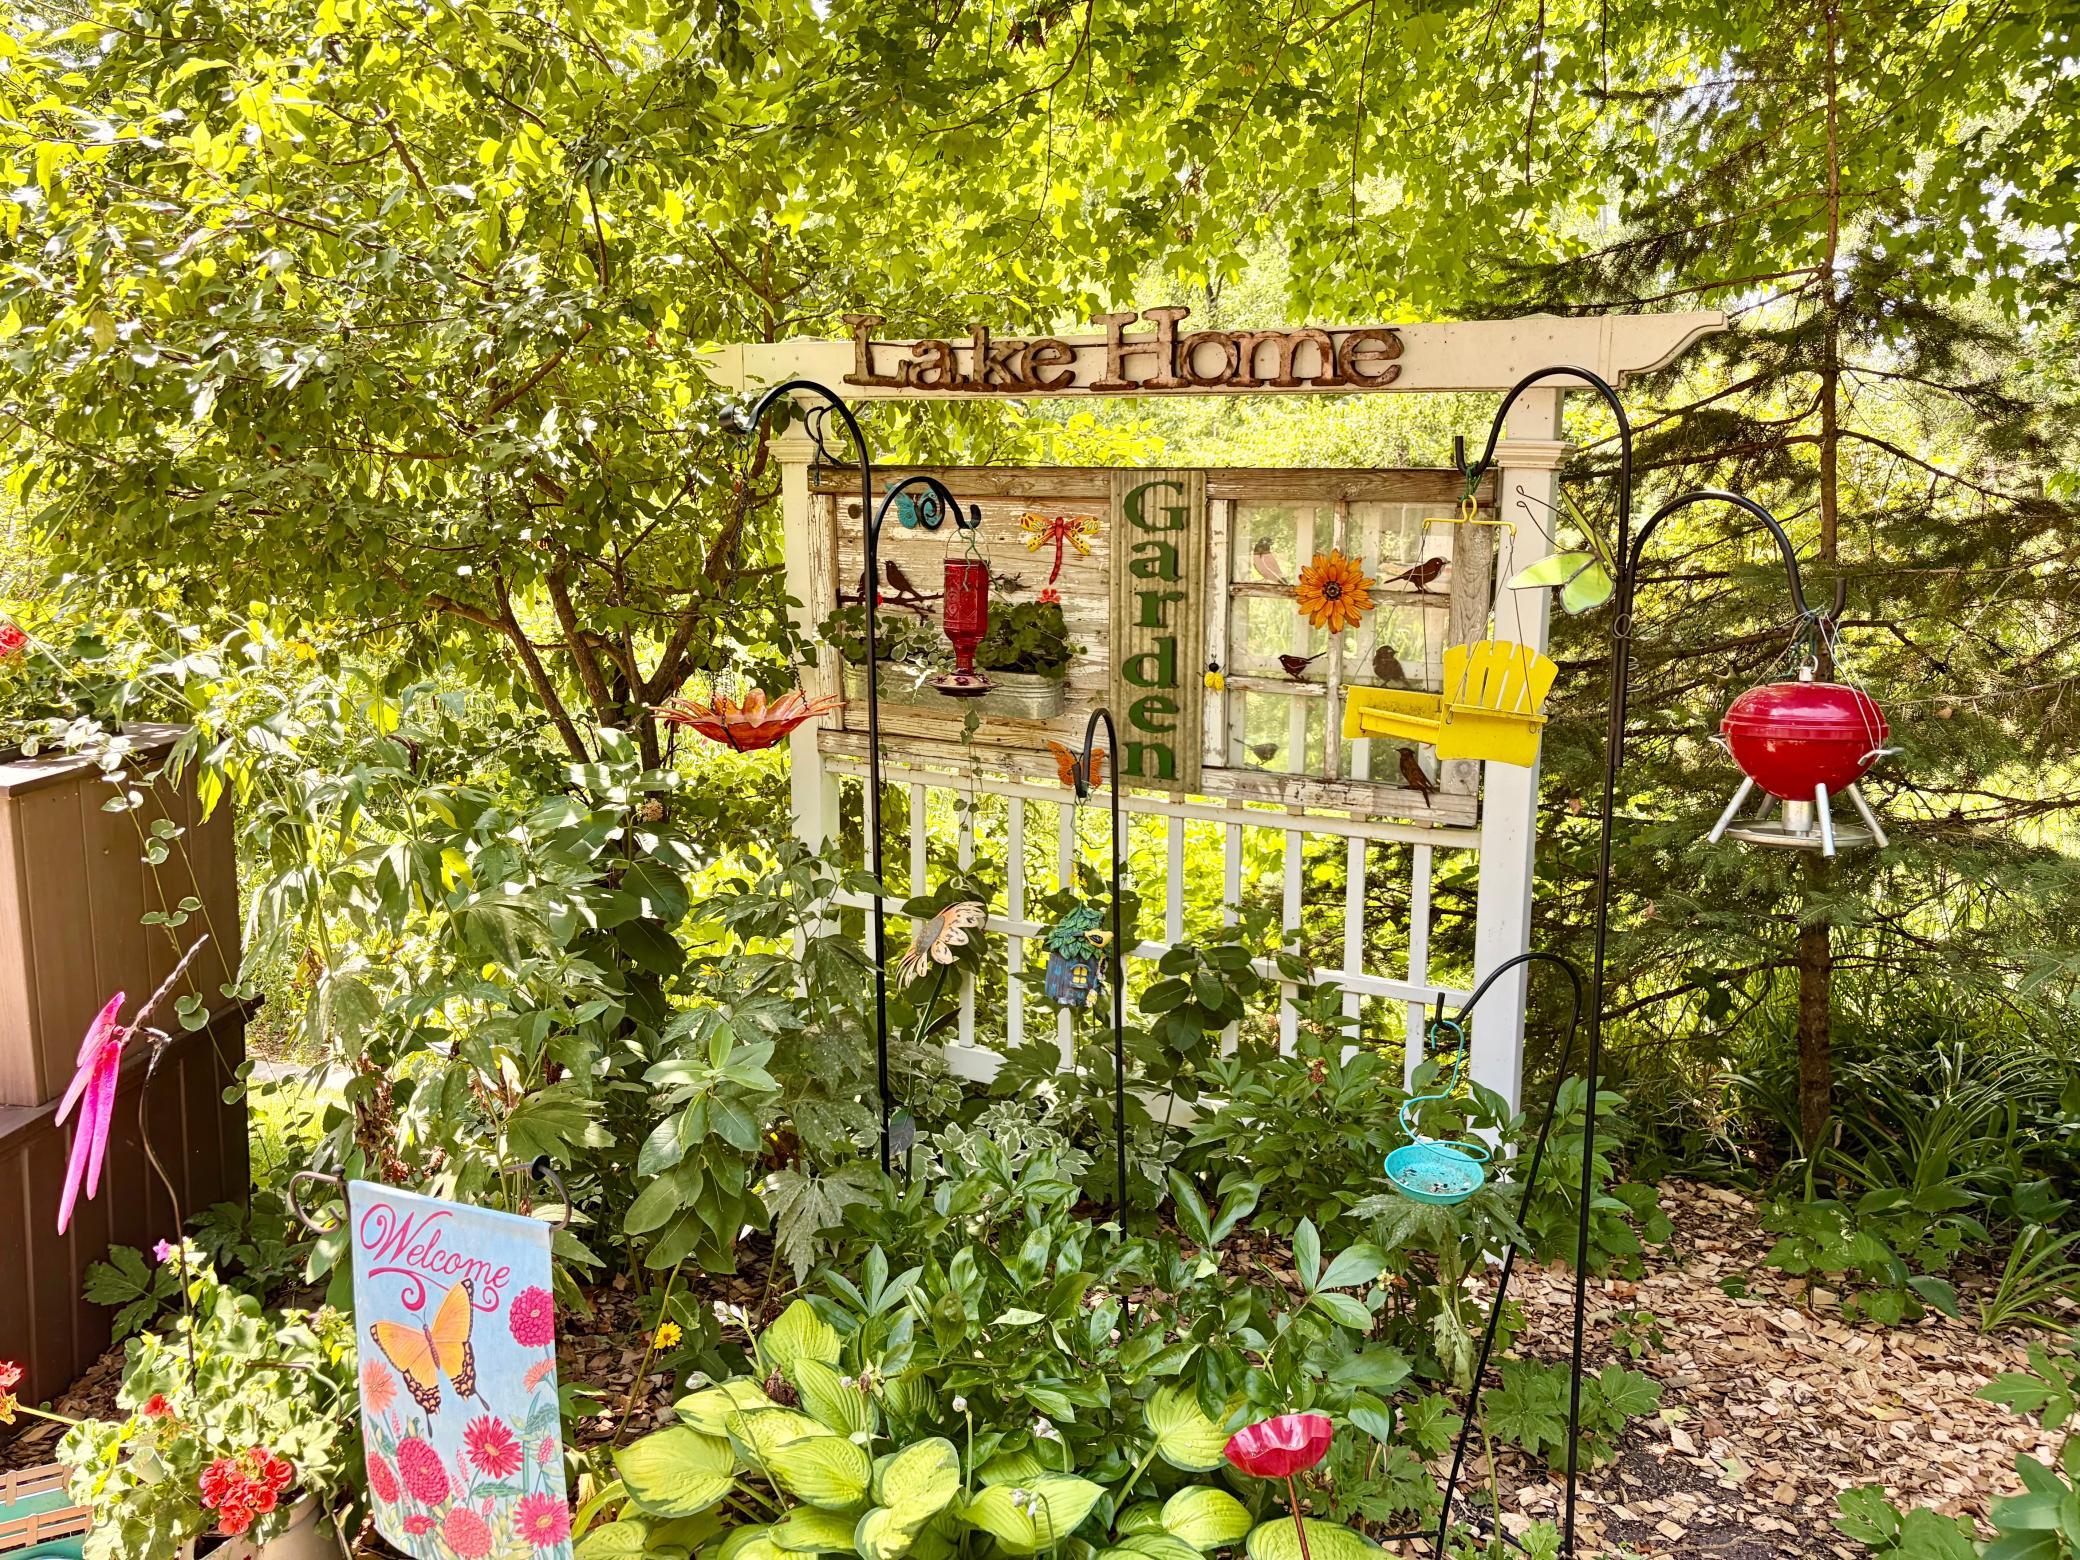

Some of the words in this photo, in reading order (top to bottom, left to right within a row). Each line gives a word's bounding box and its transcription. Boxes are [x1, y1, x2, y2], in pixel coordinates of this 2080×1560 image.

[842, 313, 1076, 392] Lake
[1090, 306, 1403, 392] Home
[1121, 482, 1187, 780] Garden
[360, 1203, 510, 1289] Welcome
